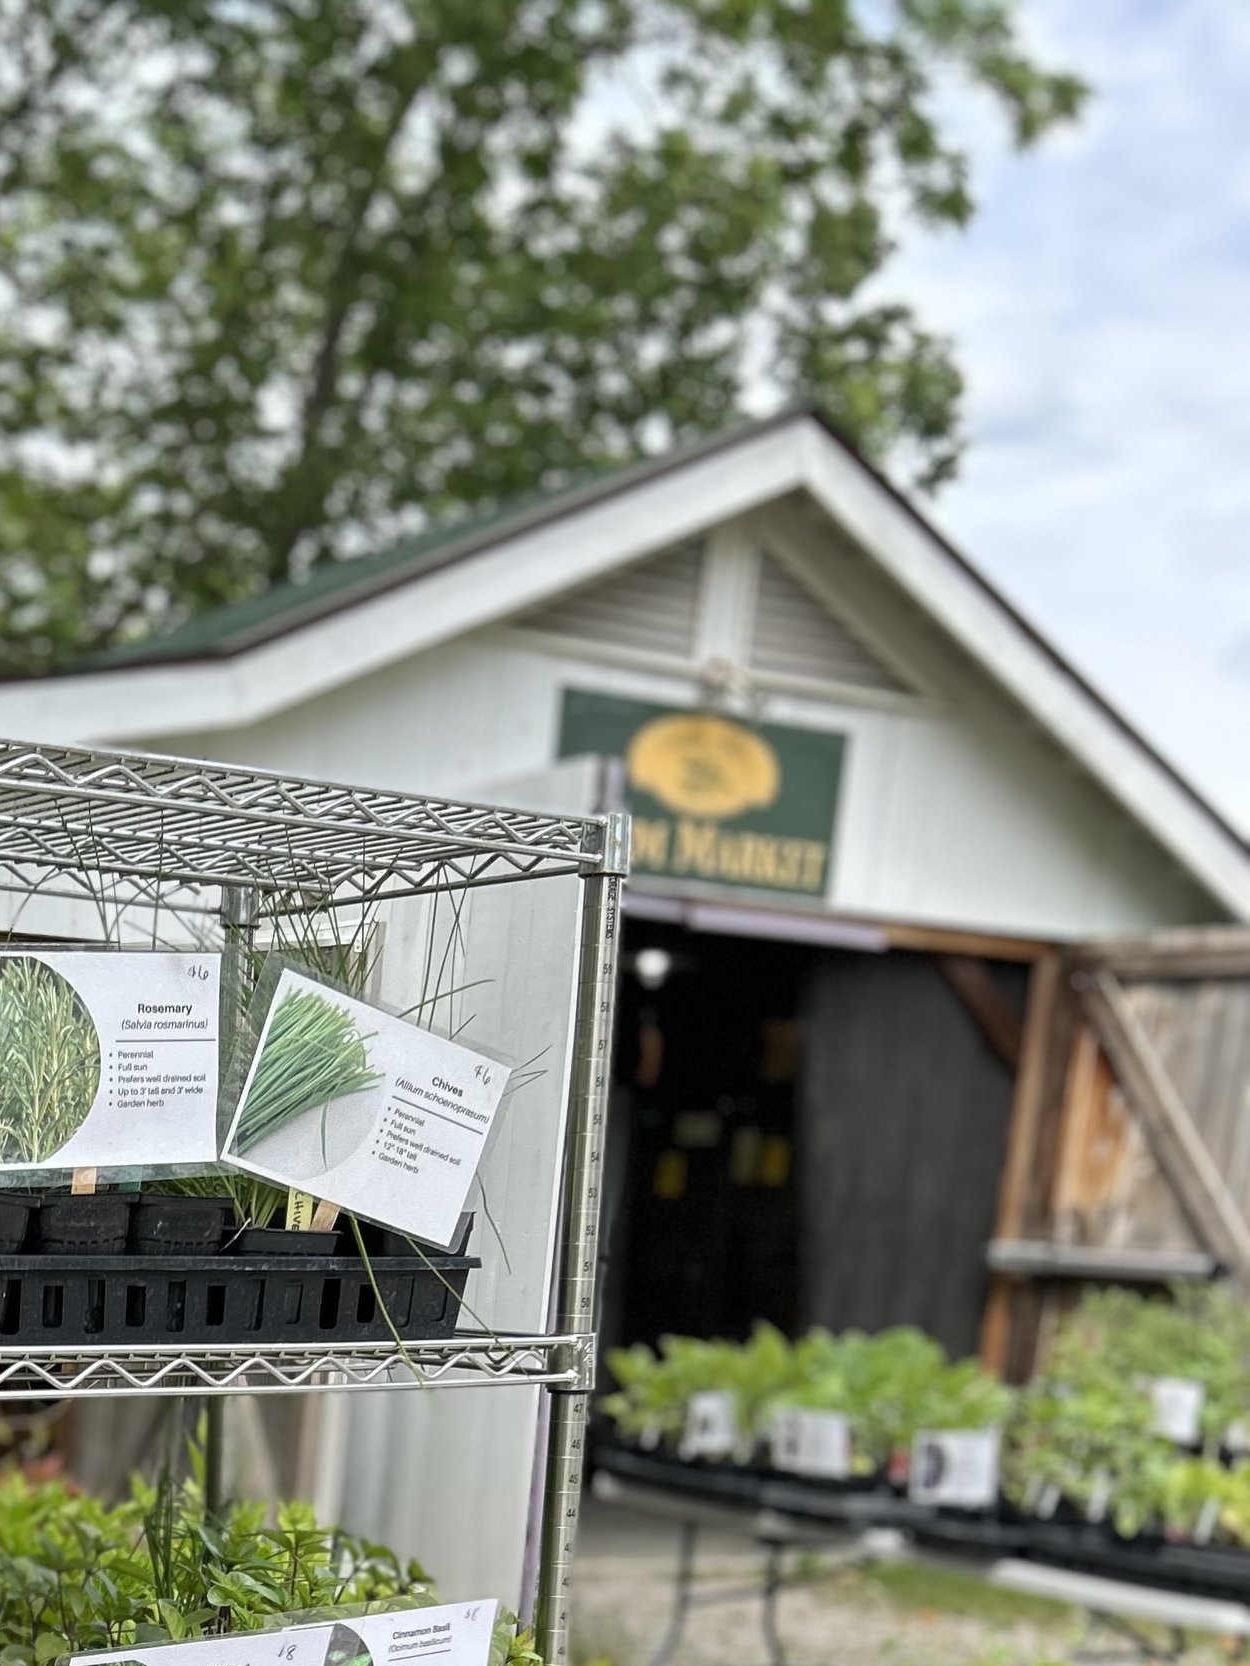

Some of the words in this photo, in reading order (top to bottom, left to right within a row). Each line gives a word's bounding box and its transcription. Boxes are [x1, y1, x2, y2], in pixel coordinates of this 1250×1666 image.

[137, 1003, 192, 1015] Rosemary
[121, 1019, 152, 1030] (Salvia
[153, 1018, 208, 1029] rosmarinus)
[117, 1050, 153, 1059] Perennial
[117, 1062, 132, 1071] Full
[133, 1063, 147, 1071] sun
[117, 1075, 144, 1083] Prefers
[145, 1074, 161, 1082] well
[162, 1073, 191, 1082] drained
[193, 1073, 206, 1082] soil
[117, 1087, 129, 1097] Up
[147, 1086, 159, 1095] tall
[160, 1086, 175, 1095] and
[184, 1085, 203, 1094] wide
[431, 1076, 463, 1097] Chives
[394, 1076, 424, 1096] (Allium
[423, 1090, 490, 1124] schoenoprasum)
[586, 1226, 595, 1236] 52
[574, 1404, 583, 1414] 47
[569, 1474, 578, 1484] 45
[566, 1508, 576, 1518] 44
[392, 1627, 431, 1640] Cinnamon
[432, 1622, 451, 1633] Basil
[388, 1642, 418, 1653] (Ocimum
[418, 1635, 452, 1648] basilicum)
